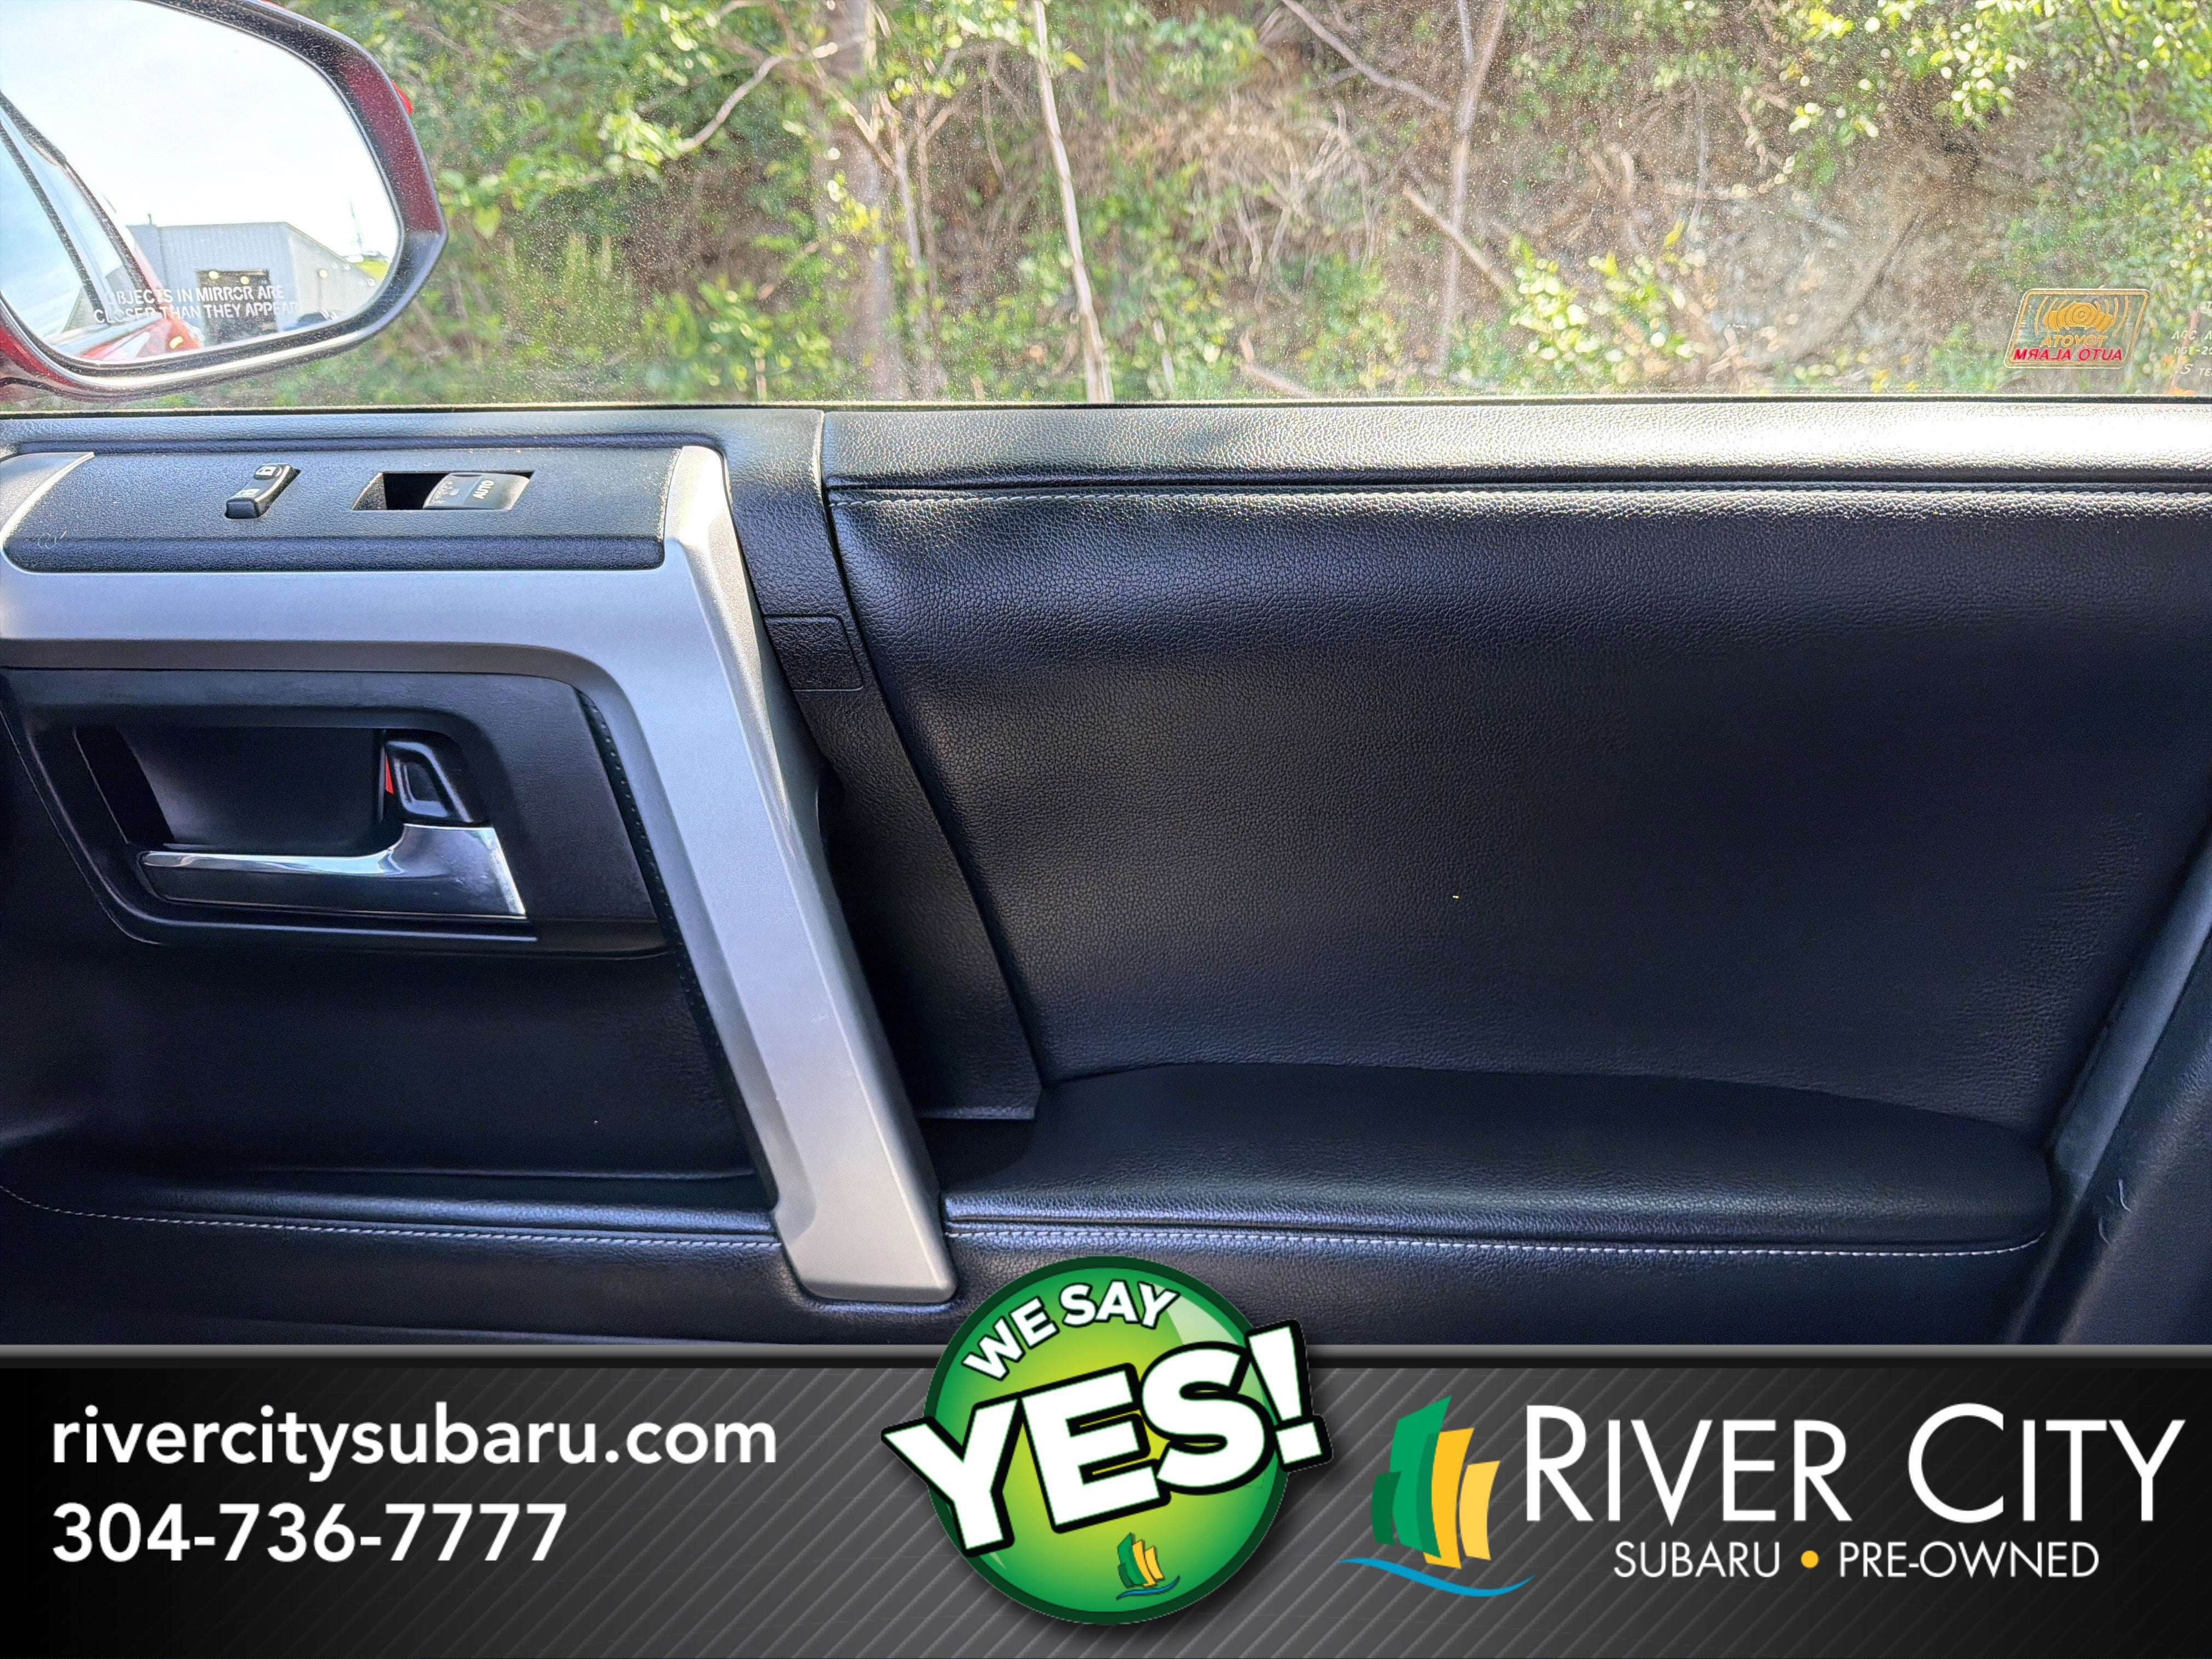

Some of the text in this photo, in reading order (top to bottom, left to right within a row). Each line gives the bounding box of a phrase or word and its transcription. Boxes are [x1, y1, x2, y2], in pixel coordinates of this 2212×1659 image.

[105, 285, 285, 304] BJECTS IN MIRROR ARE
[93, 301, 299, 324] CLOSER THAN THEY APPEAR
[472, 479, 494, 499] AUTO
